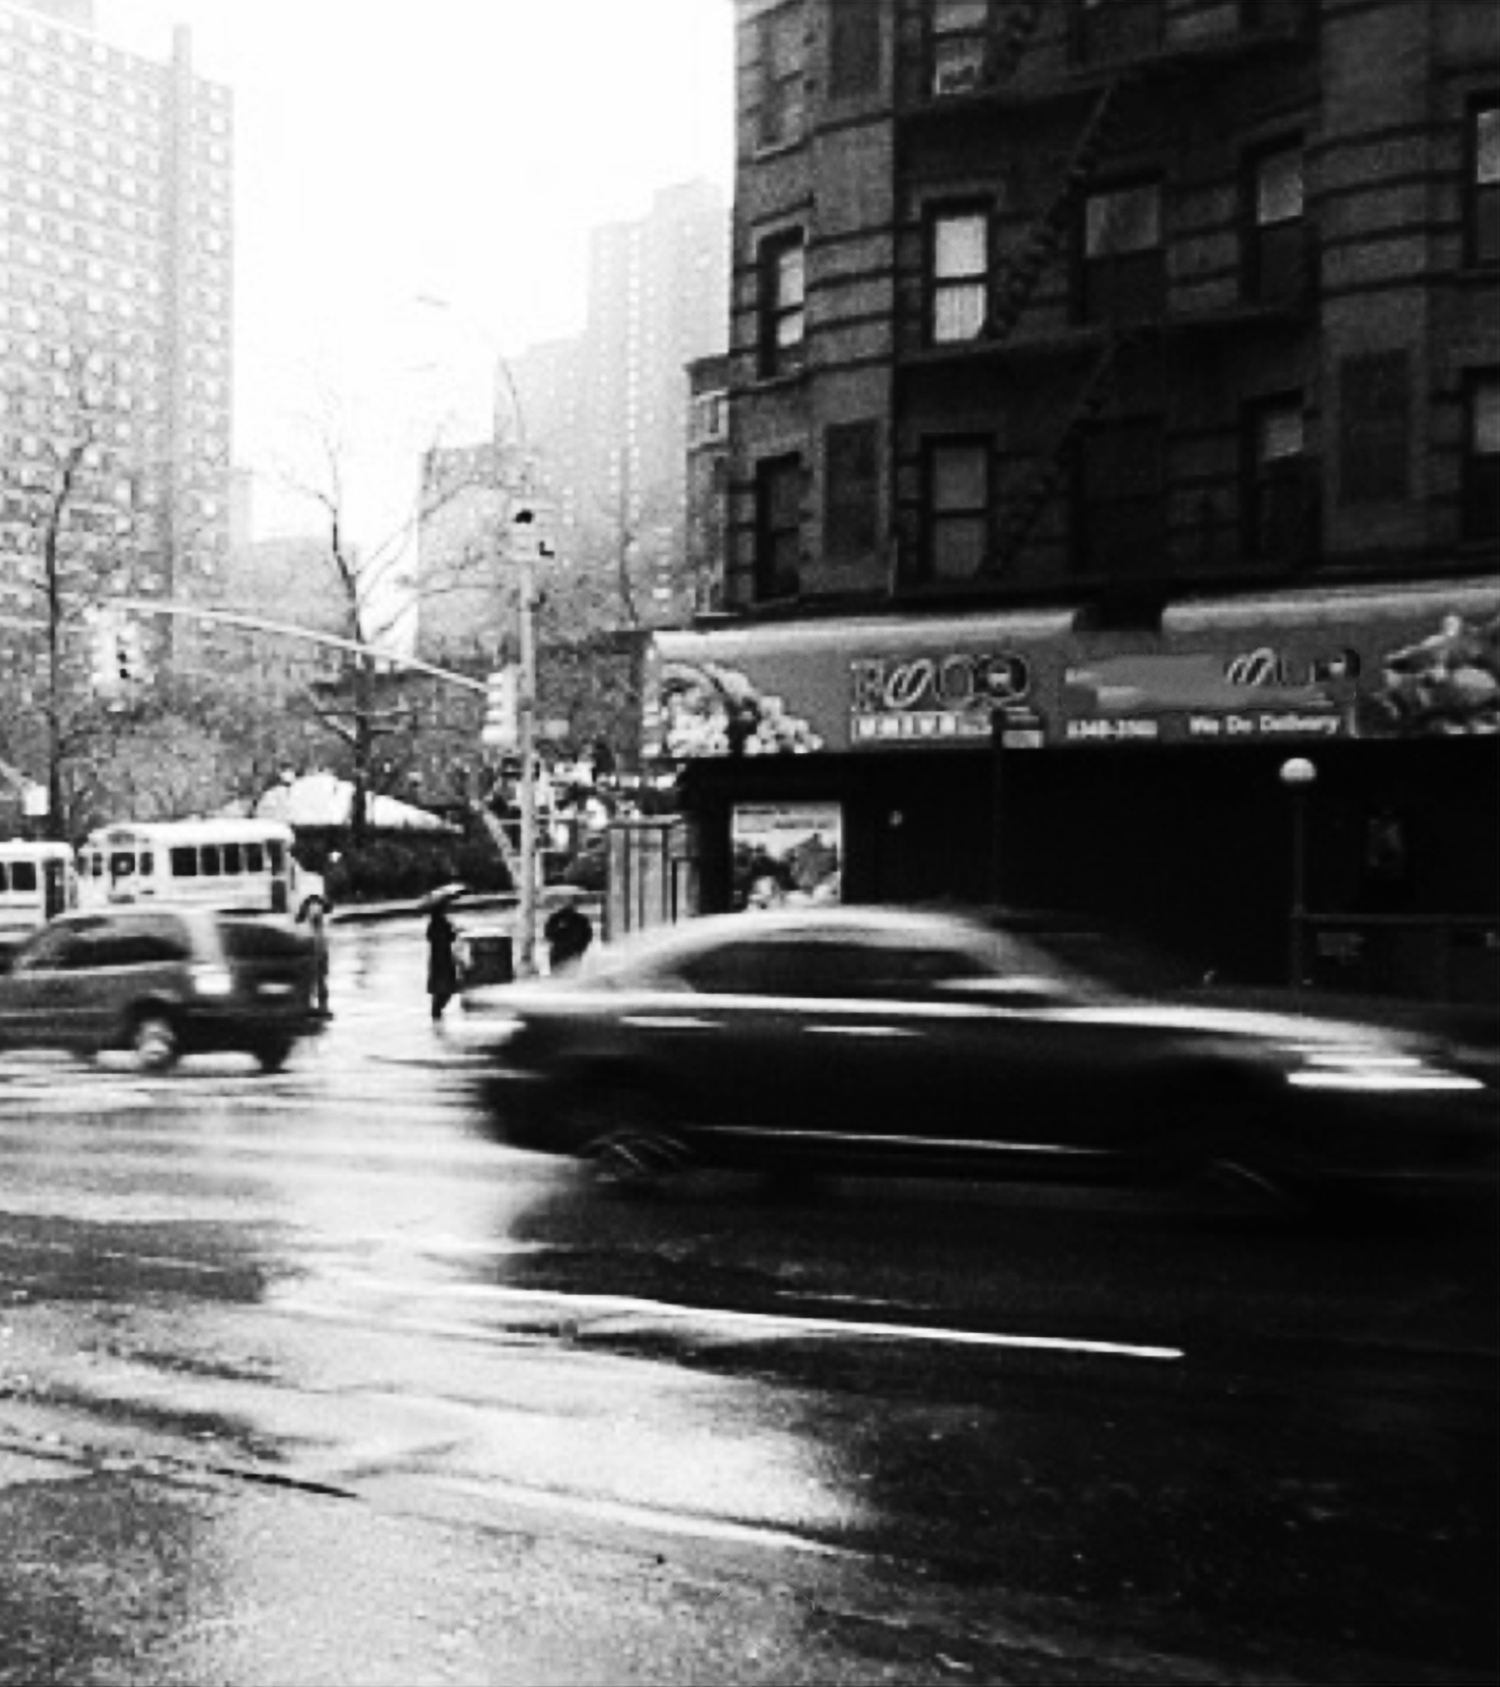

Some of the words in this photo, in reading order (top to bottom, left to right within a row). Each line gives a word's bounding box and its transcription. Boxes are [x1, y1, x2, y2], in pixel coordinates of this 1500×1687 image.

[1188, 714, 1219, 735] We
[1226, 713, 1254, 735] Do
[1259, 712, 1341, 735] Delivery
